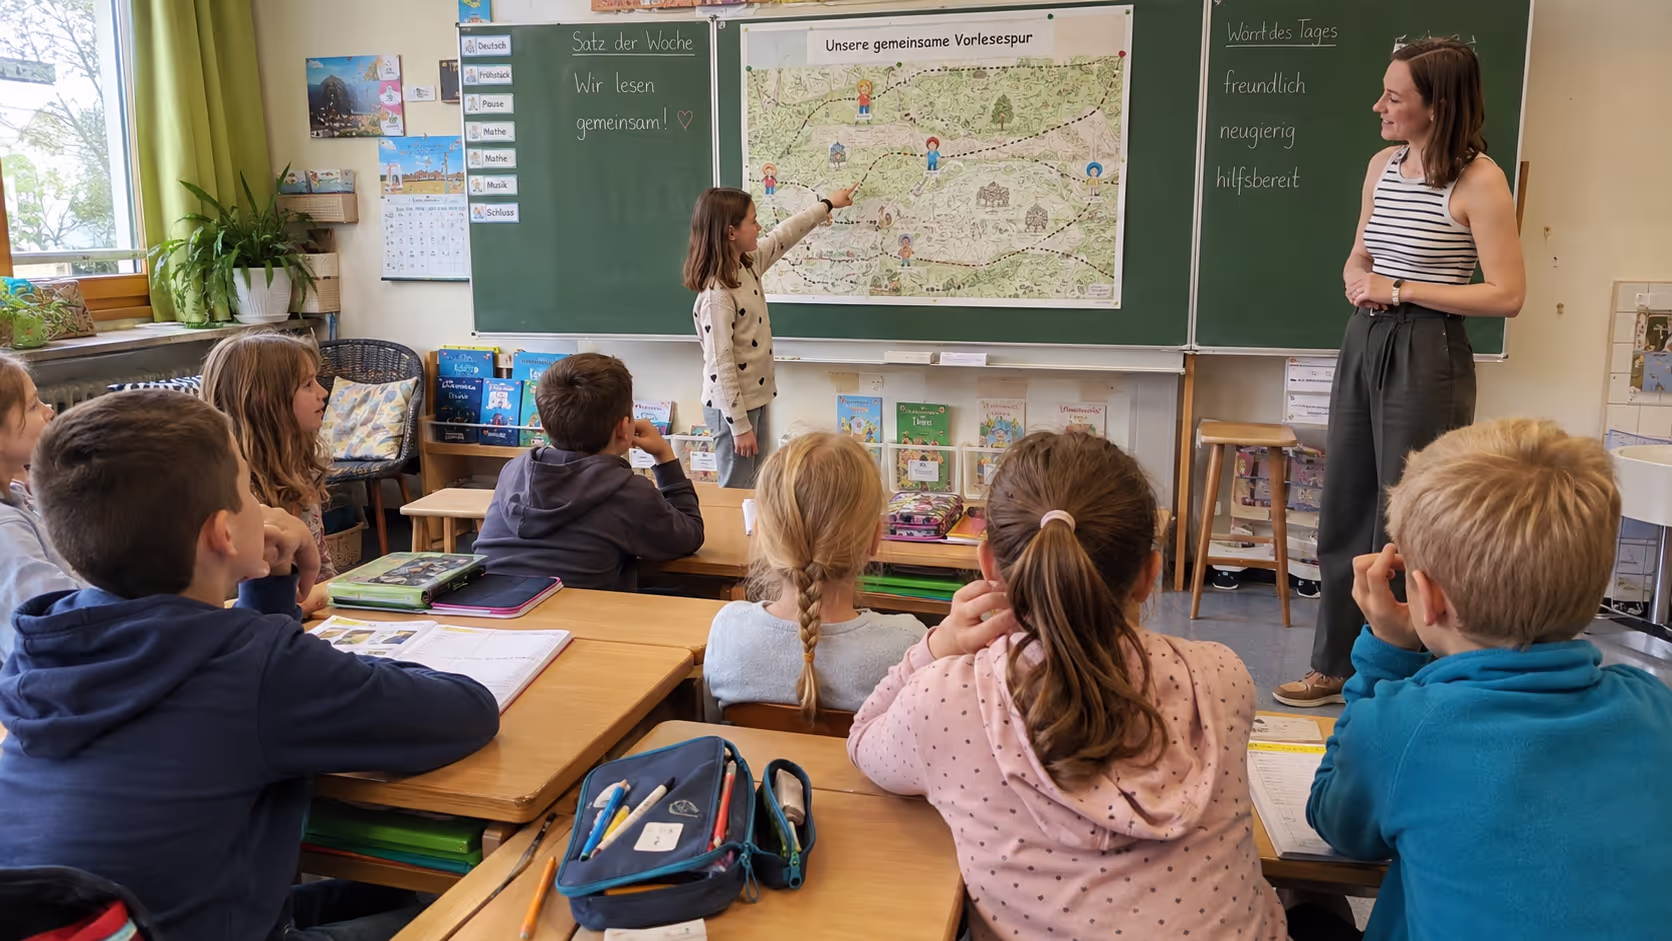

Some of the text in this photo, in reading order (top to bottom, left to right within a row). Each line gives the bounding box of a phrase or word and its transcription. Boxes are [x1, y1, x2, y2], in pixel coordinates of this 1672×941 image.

[572, 30, 694, 51] Satz der Woche
[1268, 21, 1293, 41] des
[1297, 18, 1339, 46] Tages
[478, 41, 507, 50] Deutsch
[825, 32, 1034, 54] Unsere gemeinsame Vorlesespur
[574, 72, 655, 94] Wir lesen
[1223, 70, 1306, 94] freundlich
[482, 99, 504, 108] Pause
[483, 127, 507, 136] Mathe
[576, 107, 668, 141] gemeinsam!
[1220, 122, 1296, 149] neugierig
[485, 154, 508, 163] Mathe
[486, 181, 508, 190] Musik
[1216, 166, 1300, 196] hilfsbereit
[486, 208, 515, 217] Schluss
